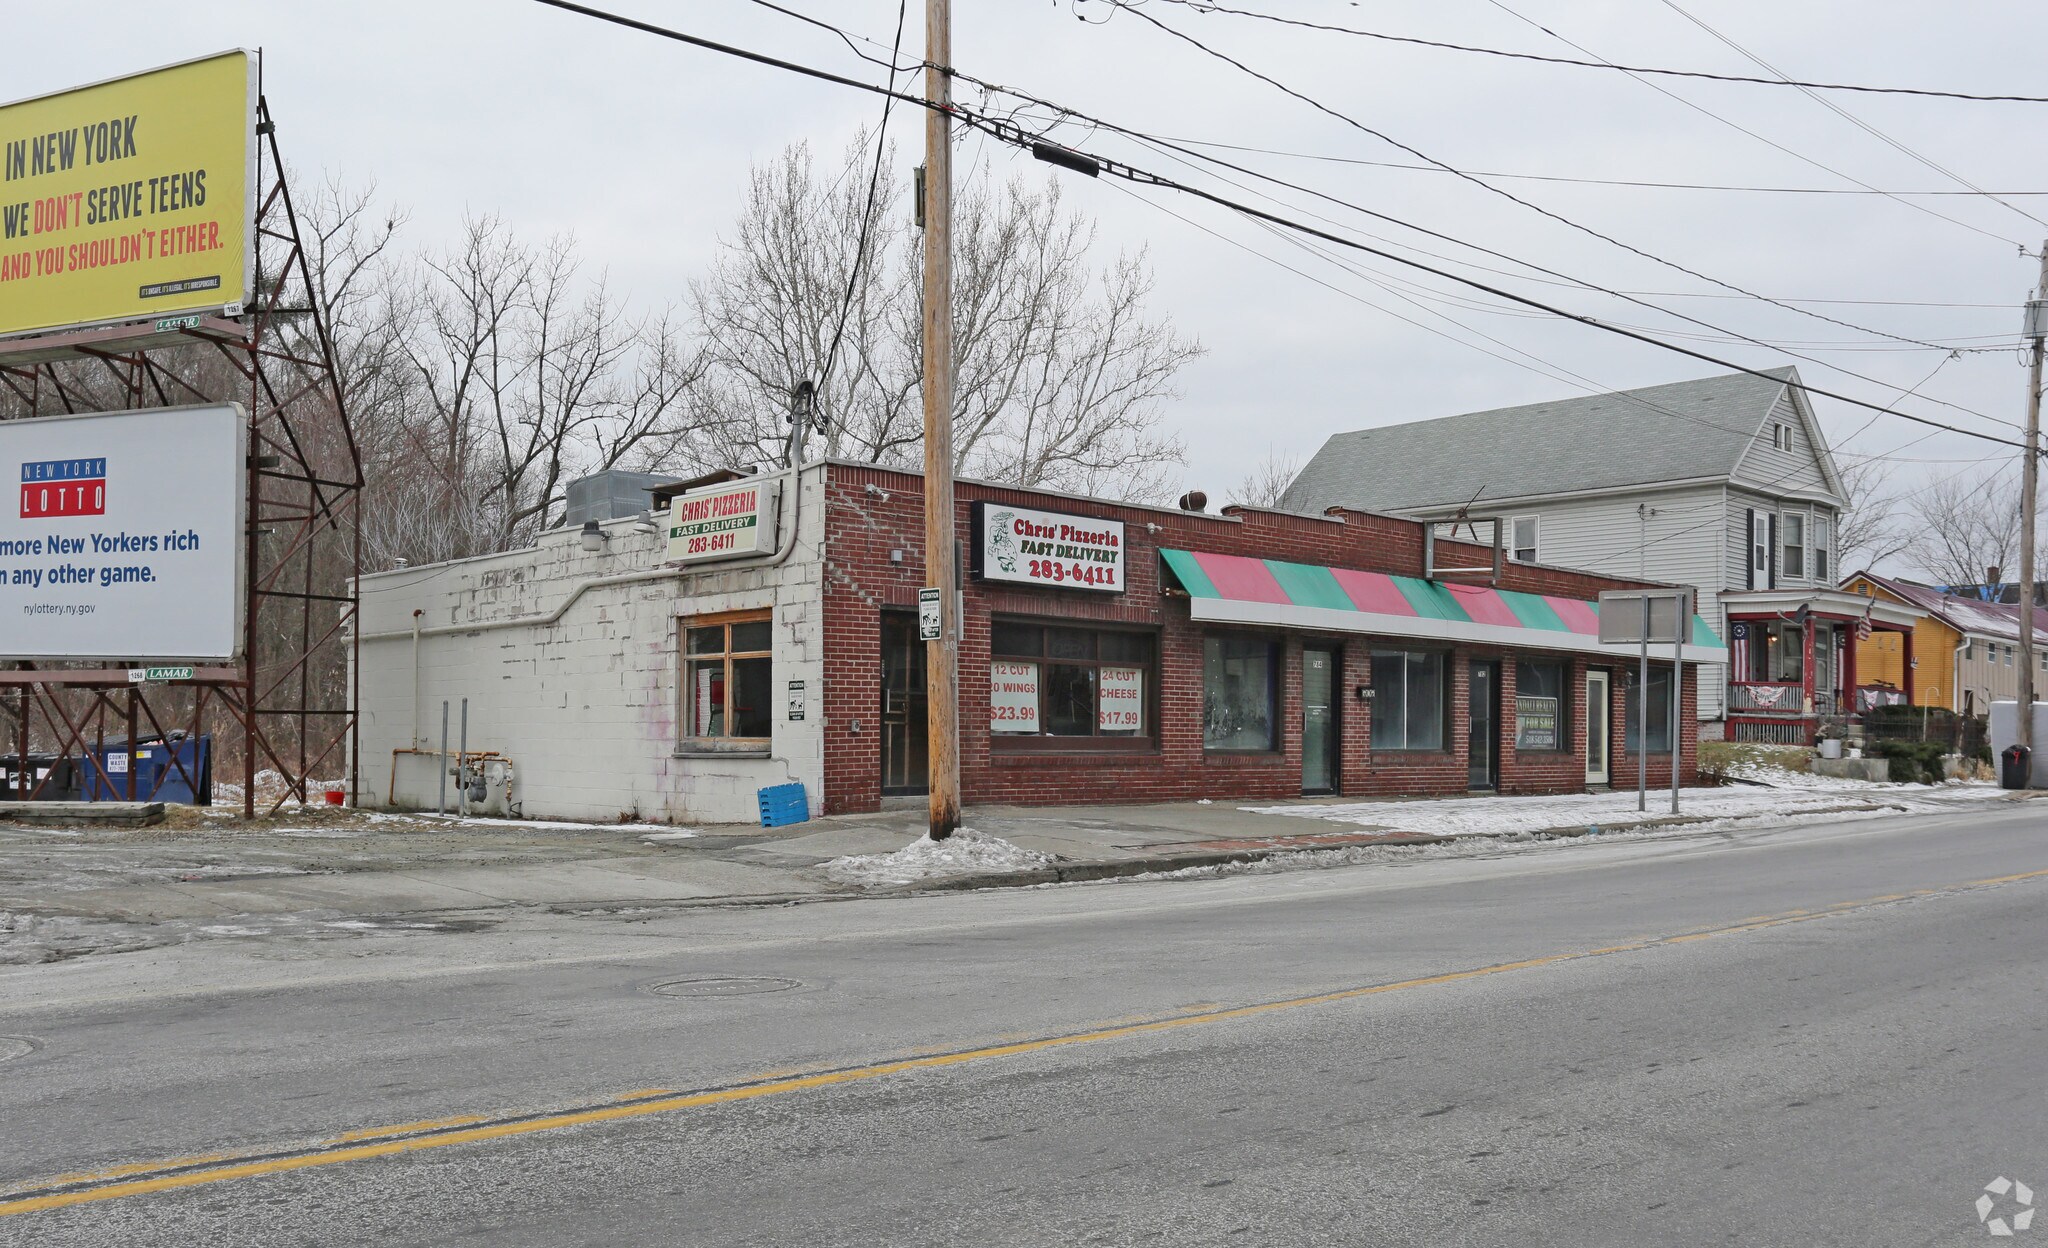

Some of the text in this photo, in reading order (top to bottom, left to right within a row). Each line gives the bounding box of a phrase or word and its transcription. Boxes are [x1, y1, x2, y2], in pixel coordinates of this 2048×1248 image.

[6, 115, 138, 181] IN NEW YORK
[4, 169, 206, 239] WE DON'T SERVE TEENS
[1, 221, 224, 281] AND YOU SHOULDN'T EITHER.
[24, 460, 102, 478] NEW YORK
[24, 486, 102, 512] LOTTO
[682, 491, 756, 522] CHRIS' PIZZERIA
[676, 517, 750, 536] FAST DELIVERY
[1014, 519, 1118, 547] Chris' Pizzeria
[0, 530, 199, 556] more New Yorkers rich
[688, 533, 735, 554] 283-6411
[1020, 540, 1118, 563] FAST DELIVERY
[12, 568, 42, 588] any
[48, 564, 95, 584] other
[100, 566, 156, 587] game.
[1029, 560, 1115, 585] 283-6411
[24, 603, 96, 616] nylottery.ny.gov
[150, 669, 188, 678] LAMAR
[995, 665, 1030, 676] 12 CUT
[1102, 671, 1136, 681] 24 CUT
[1003, 683, 1035, 693] WINGS
[1100, 689, 1137, 699] CHEESE
[991, 706, 1035, 720] $23.99
[1536, 700, 1555, 712] REALTY
[1100, 712, 1137, 725] $17.99
[1526, 718, 1554, 728] FOR SALE
